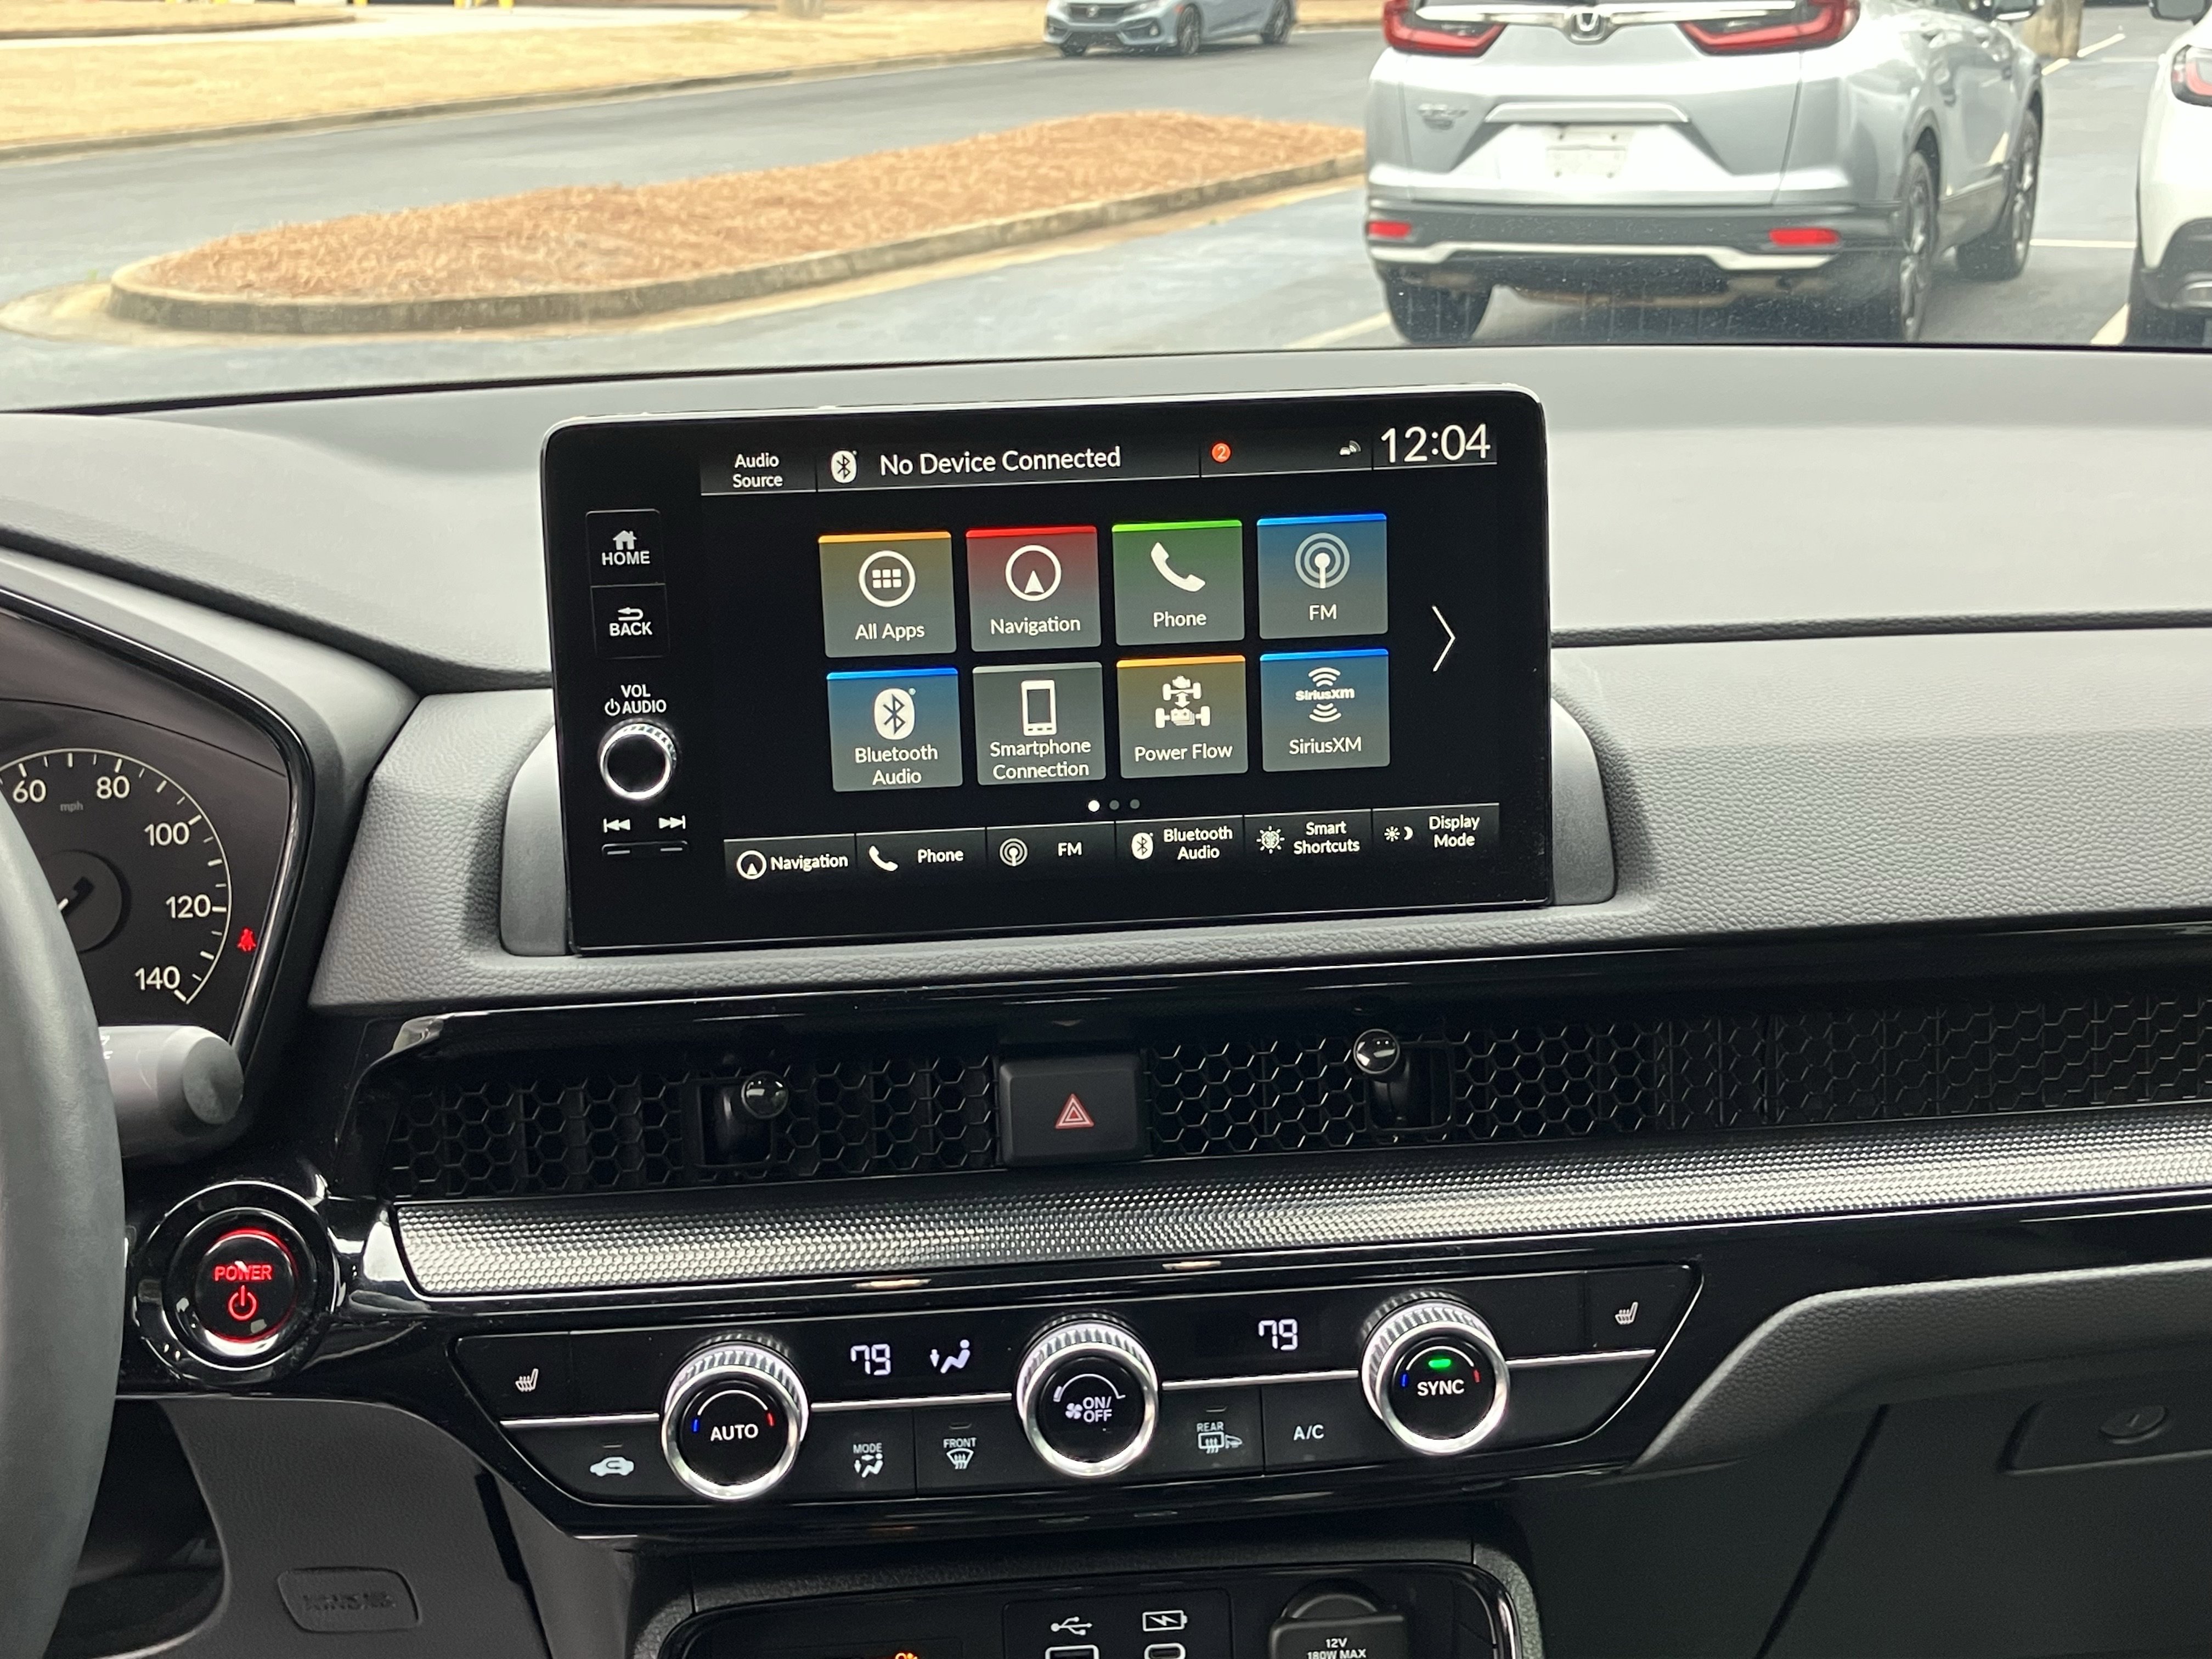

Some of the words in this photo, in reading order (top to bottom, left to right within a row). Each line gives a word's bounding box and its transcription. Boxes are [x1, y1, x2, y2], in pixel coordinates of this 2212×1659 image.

[1381, 424, 1490, 462] 12:04
[1217, 445, 1227, 459] 2
[735, 453, 779, 468] Audio
[881, 455, 913, 475] No
[920, 452, 996, 474] Device
[1002, 446, 1120, 471] Connected
[733, 474, 782, 488] Source
[602, 551, 650, 565] HOME
[1154, 612, 1206, 627] Phone
[1310, 605, 1336, 620] FM
[610, 622, 652, 636] BACK
[855, 623, 877, 640] All
[882, 623, 924, 641] Apps
[991, 616, 1080, 635] Navigation
[621, 685, 651, 698] VOL
[622, 699, 666, 714] AUDIO
[990, 739, 1091, 757] Smartphone
[1135, 747, 1187, 761] Power
[1193, 743, 1232, 759] Flow
[1289, 737, 1361, 754] SiriusXM
[855, 744, 938, 763] Bluetooth
[873, 769, 921, 785] Audio
[993, 763, 1089, 780] Connection
[13, 780, 46, 802] 60
[97, 776, 129, 799] 80
[60, 801, 83, 812] mph
[1306, 821, 1346, 835] Smart
[1430, 814, 1480, 831] Display
[145, 822, 189, 845] 100
[1164, 826, 1232, 842] Bluetooth
[1435, 833, 1475, 848] Mode
[1058, 842, 1081, 856] FM
[1177, 845, 1220, 860] Audio
[1294, 839, 1359, 854] Shortcuts
[771, 854, 848, 871] Navigation
[918, 849, 963, 863] Phone
[166, 895, 210, 918] 120
[136, 966, 180, 990] 140
[215, 1264, 272, 1281] POWER
[1259, 1319, 1297, 1350] 79
[851, 1344, 890, 1375] 79
[1418, 1380, 1464, 1396] SYNC
[1083, 1396, 1112, 1410] ON/
[1084, 1409, 1112, 1422] OFF
[710, 1424, 758, 1441] AUTO
[1197, 1422, 1223, 1431] REAR
[1294, 1425, 1324, 1440] A/C
[854, 1443, 882, 1453] MODE
[944, 1437, 976, 1448] FRONT
[1326, 1638, 1347, 1647] 12V
[1308, 1651, 1336, 1659] 180W
[1339, 1649, 1366, 1658] MAX
